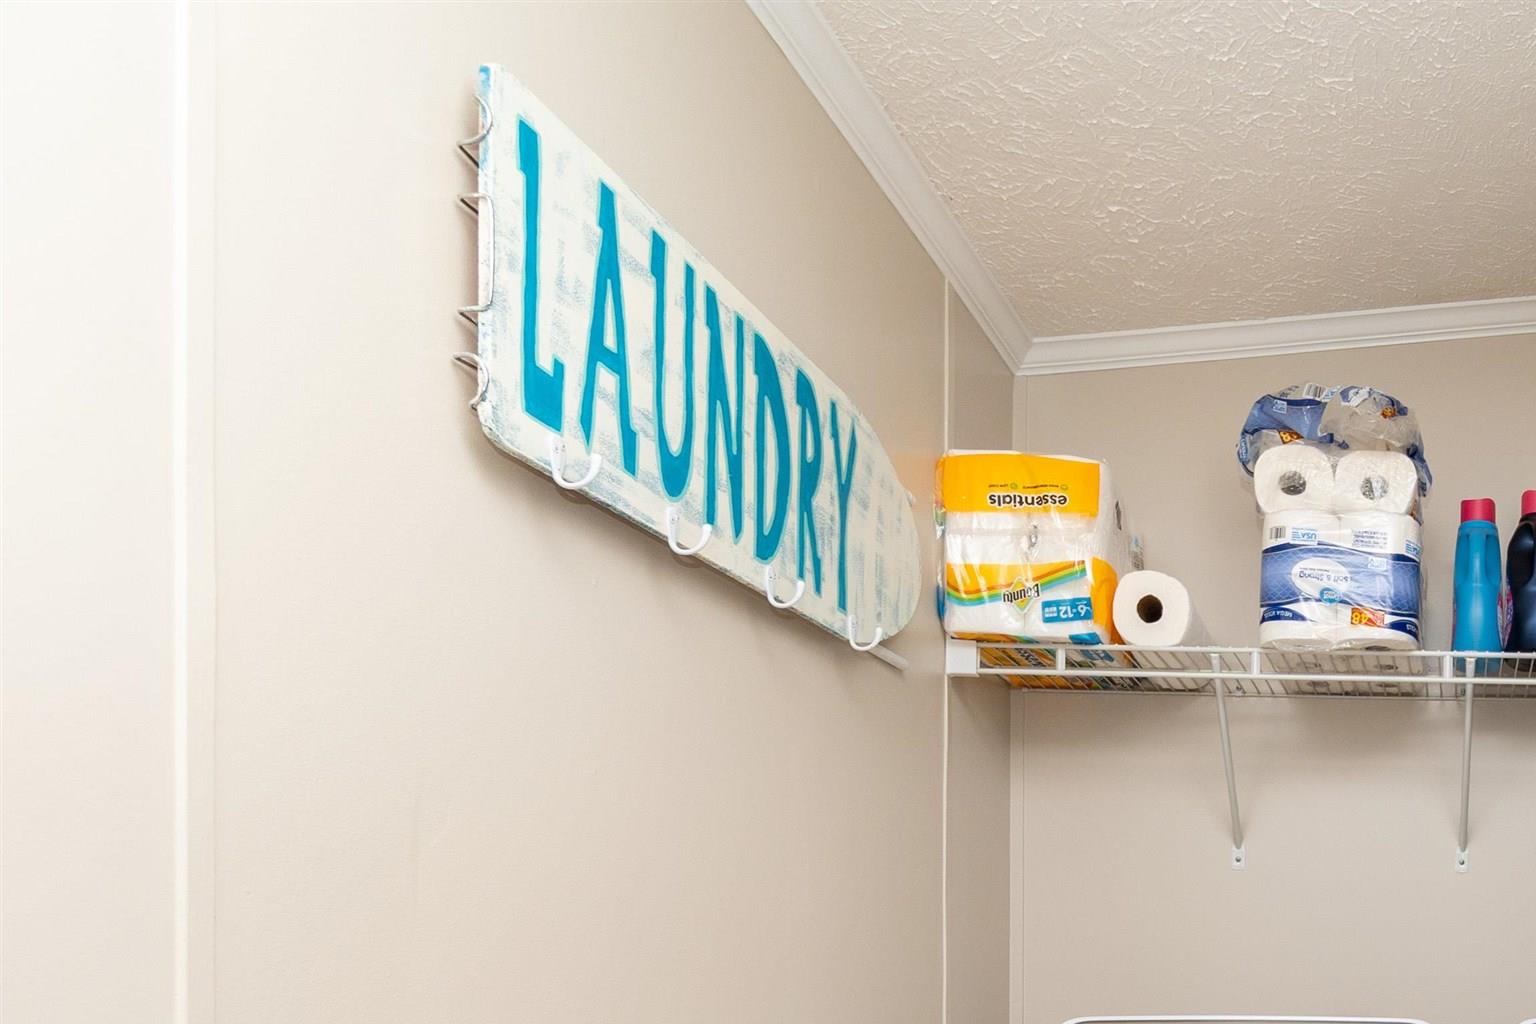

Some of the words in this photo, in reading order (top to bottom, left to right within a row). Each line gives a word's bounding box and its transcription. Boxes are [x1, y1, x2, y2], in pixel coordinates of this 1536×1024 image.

[516, 115, 858, 614] LAUNDRY
[988, 494, 1068, 508] essentials
[1003, 583, 1040, 603] Bounty
[1352, 611, 1369, 625] 48
